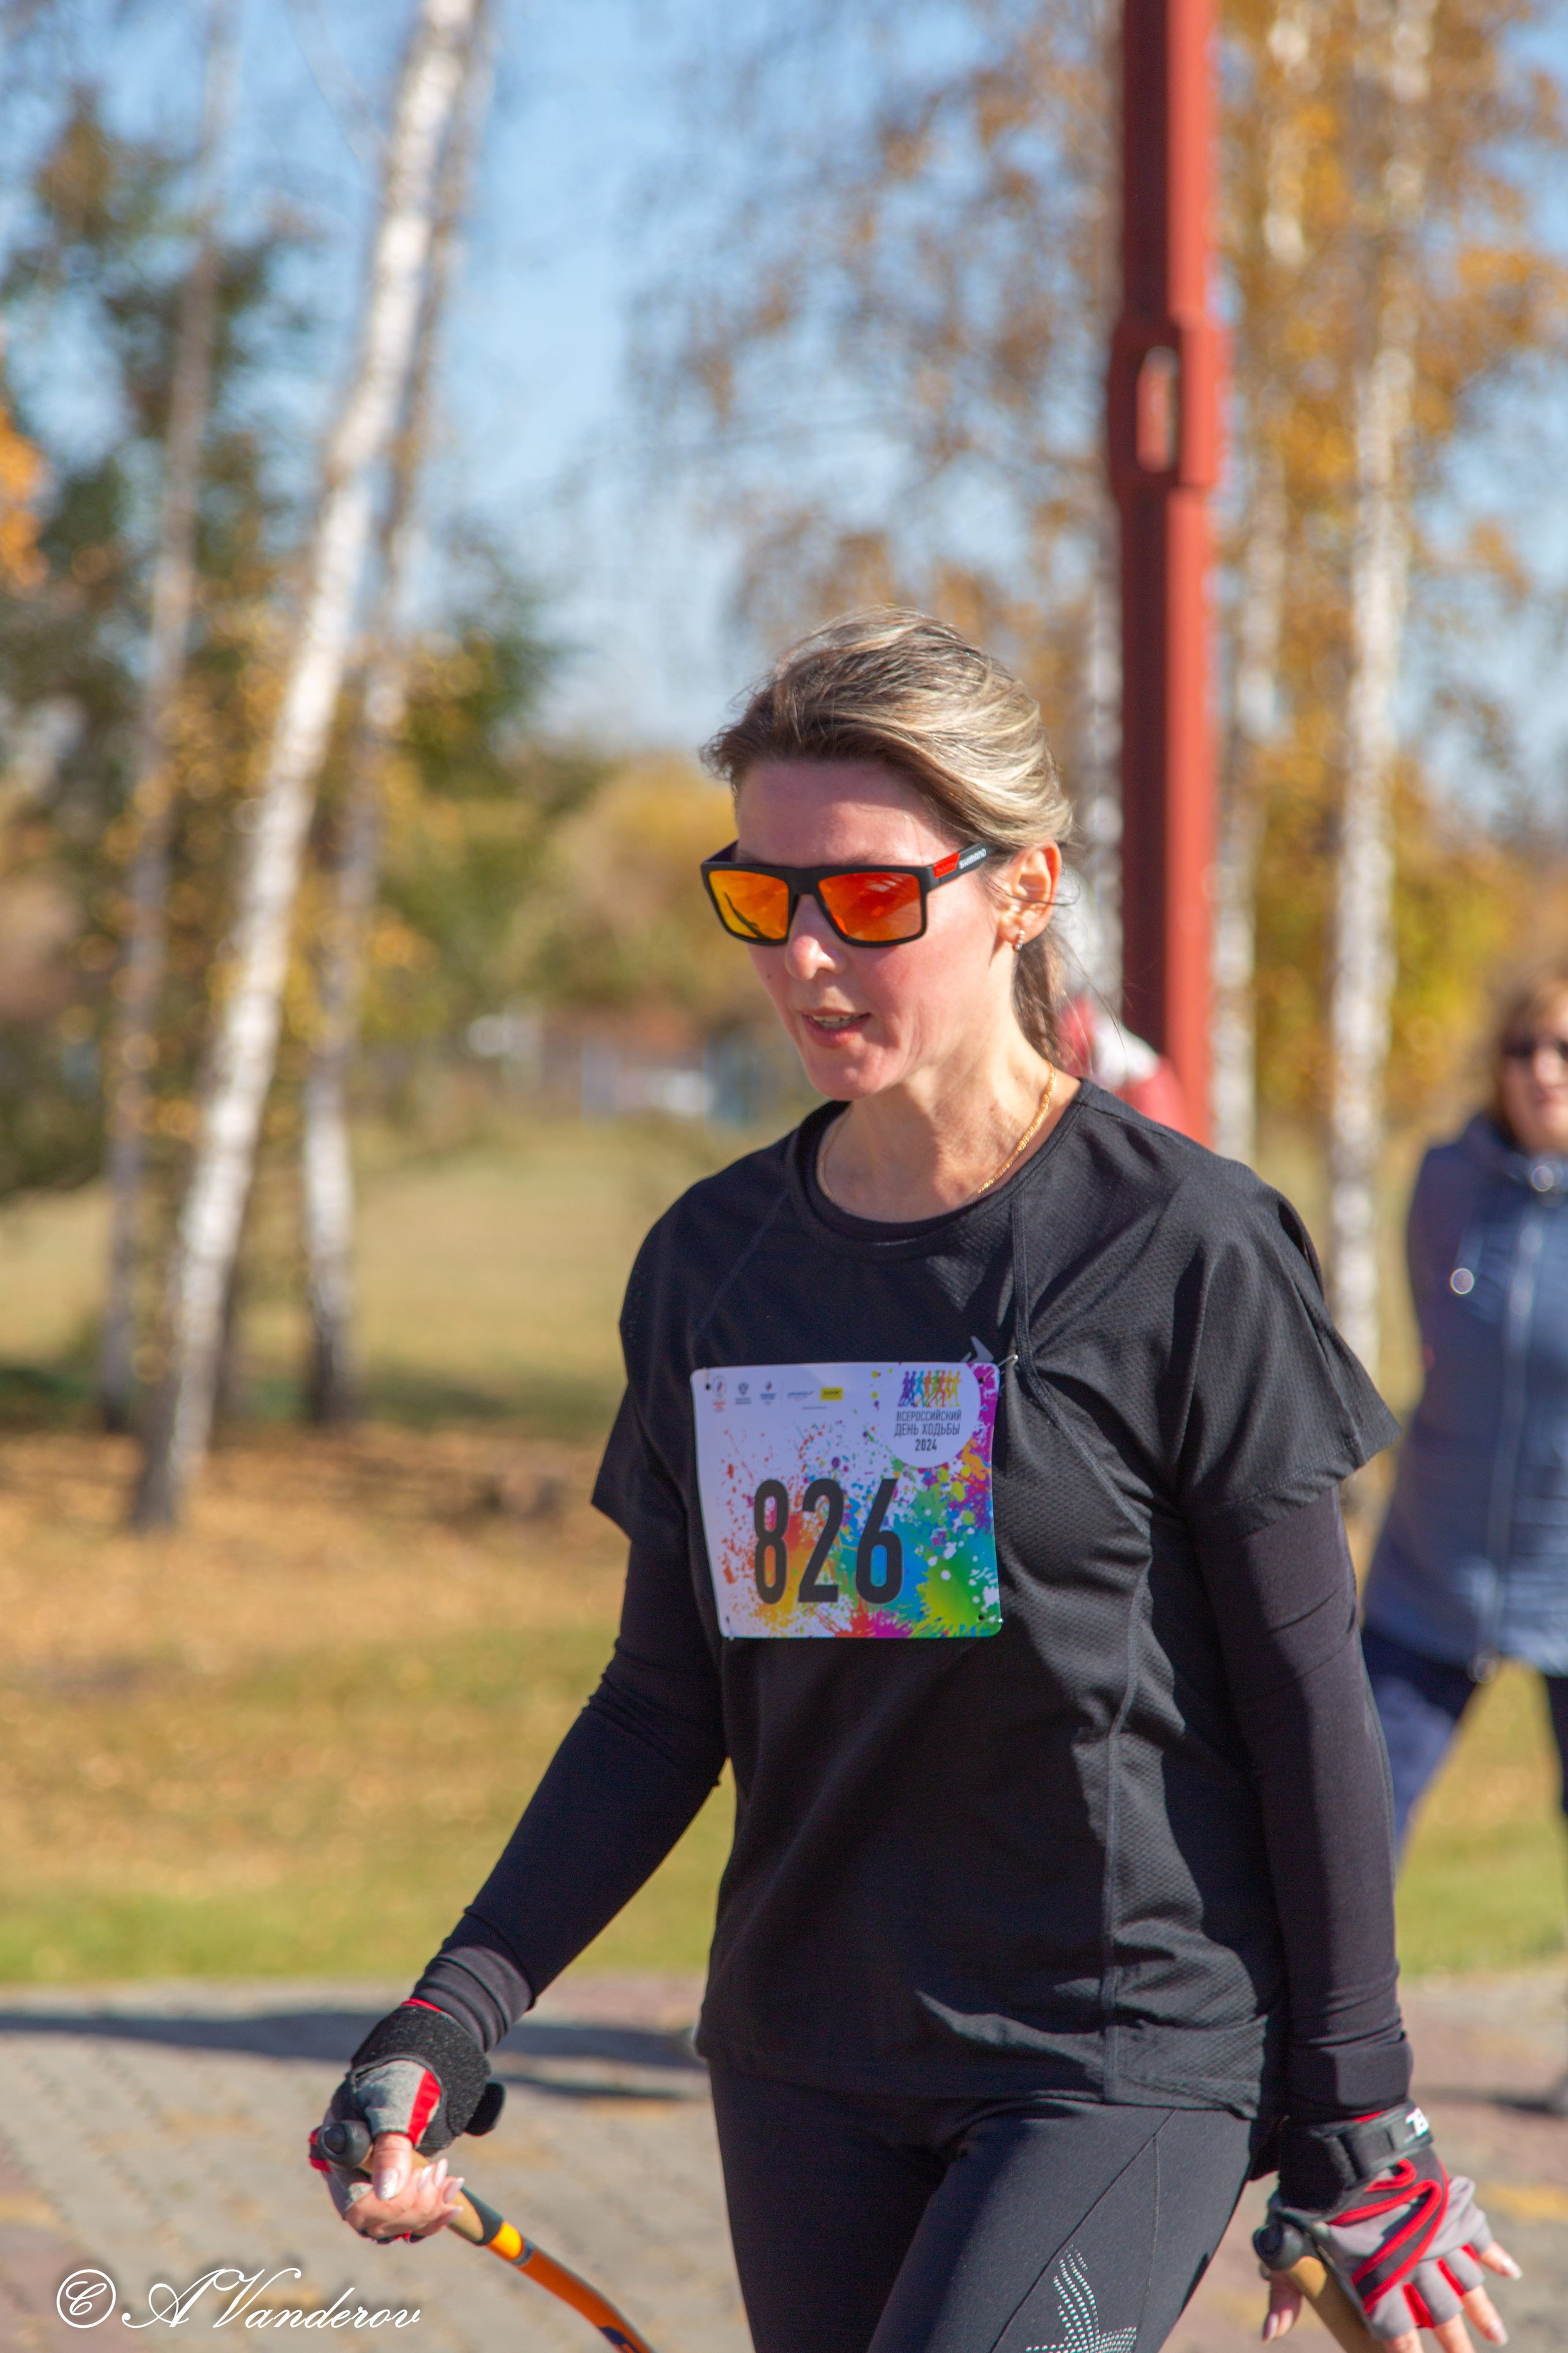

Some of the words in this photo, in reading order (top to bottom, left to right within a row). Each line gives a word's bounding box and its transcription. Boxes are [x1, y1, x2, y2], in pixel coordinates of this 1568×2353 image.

[959, 848, 987, 869] SHIMANO
[897, 1409, 962, 1422] ВСЕРОССИЙСКИЙ
[894, 1422, 919, 1437] ДЕНЬ
[922, 1422, 960, 1437] ХОДЬБЫ
[915, 1438, 937, 1451] 2024
[754, 1478, 903, 1604] 826
